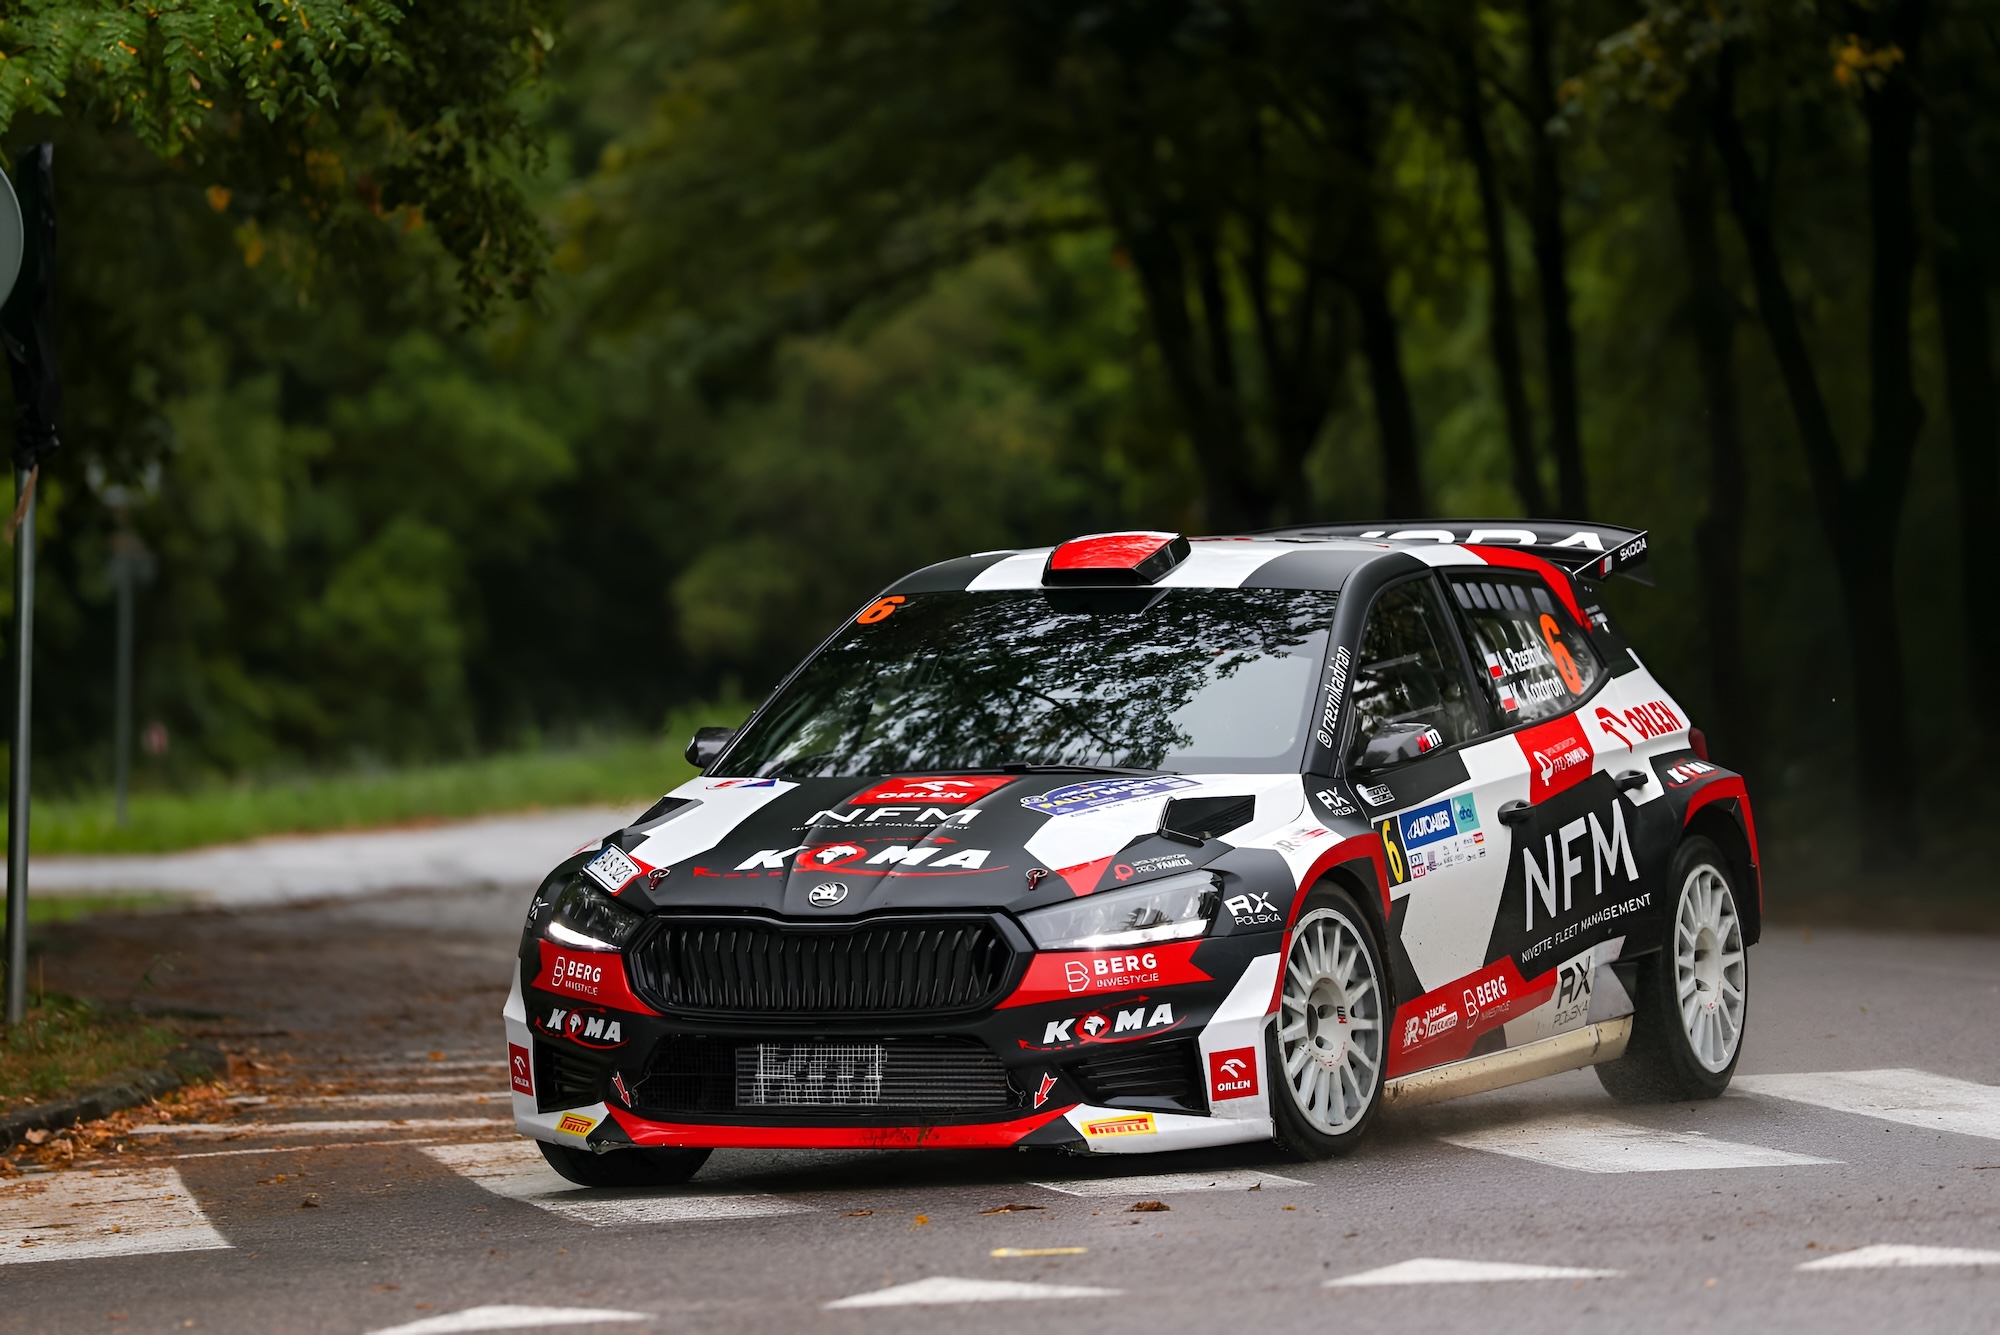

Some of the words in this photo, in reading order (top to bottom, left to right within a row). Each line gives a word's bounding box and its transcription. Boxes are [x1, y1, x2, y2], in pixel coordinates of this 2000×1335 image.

[856, 595, 906, 624] 6
[1540, 613, 1582, 695] 6
[1624, 700, 1683, 740] ORLEN
[804, 807, 983, 826] NFM
[733, 845, 991, 870] KOMA
[1382, 820, 1404, 884] 6
[1523, 797, 1640, 932] NFM
[1235, 913, 1282, 926] POLSKA
[1521, 936, 1553, 964] NIVETTE
[1555, 922, 1579, 945] FLEET
[1580, 892, 1651, 933] MANAGEMENT
[567, 960, 602, 983] BERG
[1093, 953, 1158, 976] BERG
[1476, 975, 1508, 1006] BERG
[546, 1008, 621, 1043] KOMA
[1042, 1002, 1175, 1045] KOMA
[1217, 1079, 1251, 1092] ORLEN
